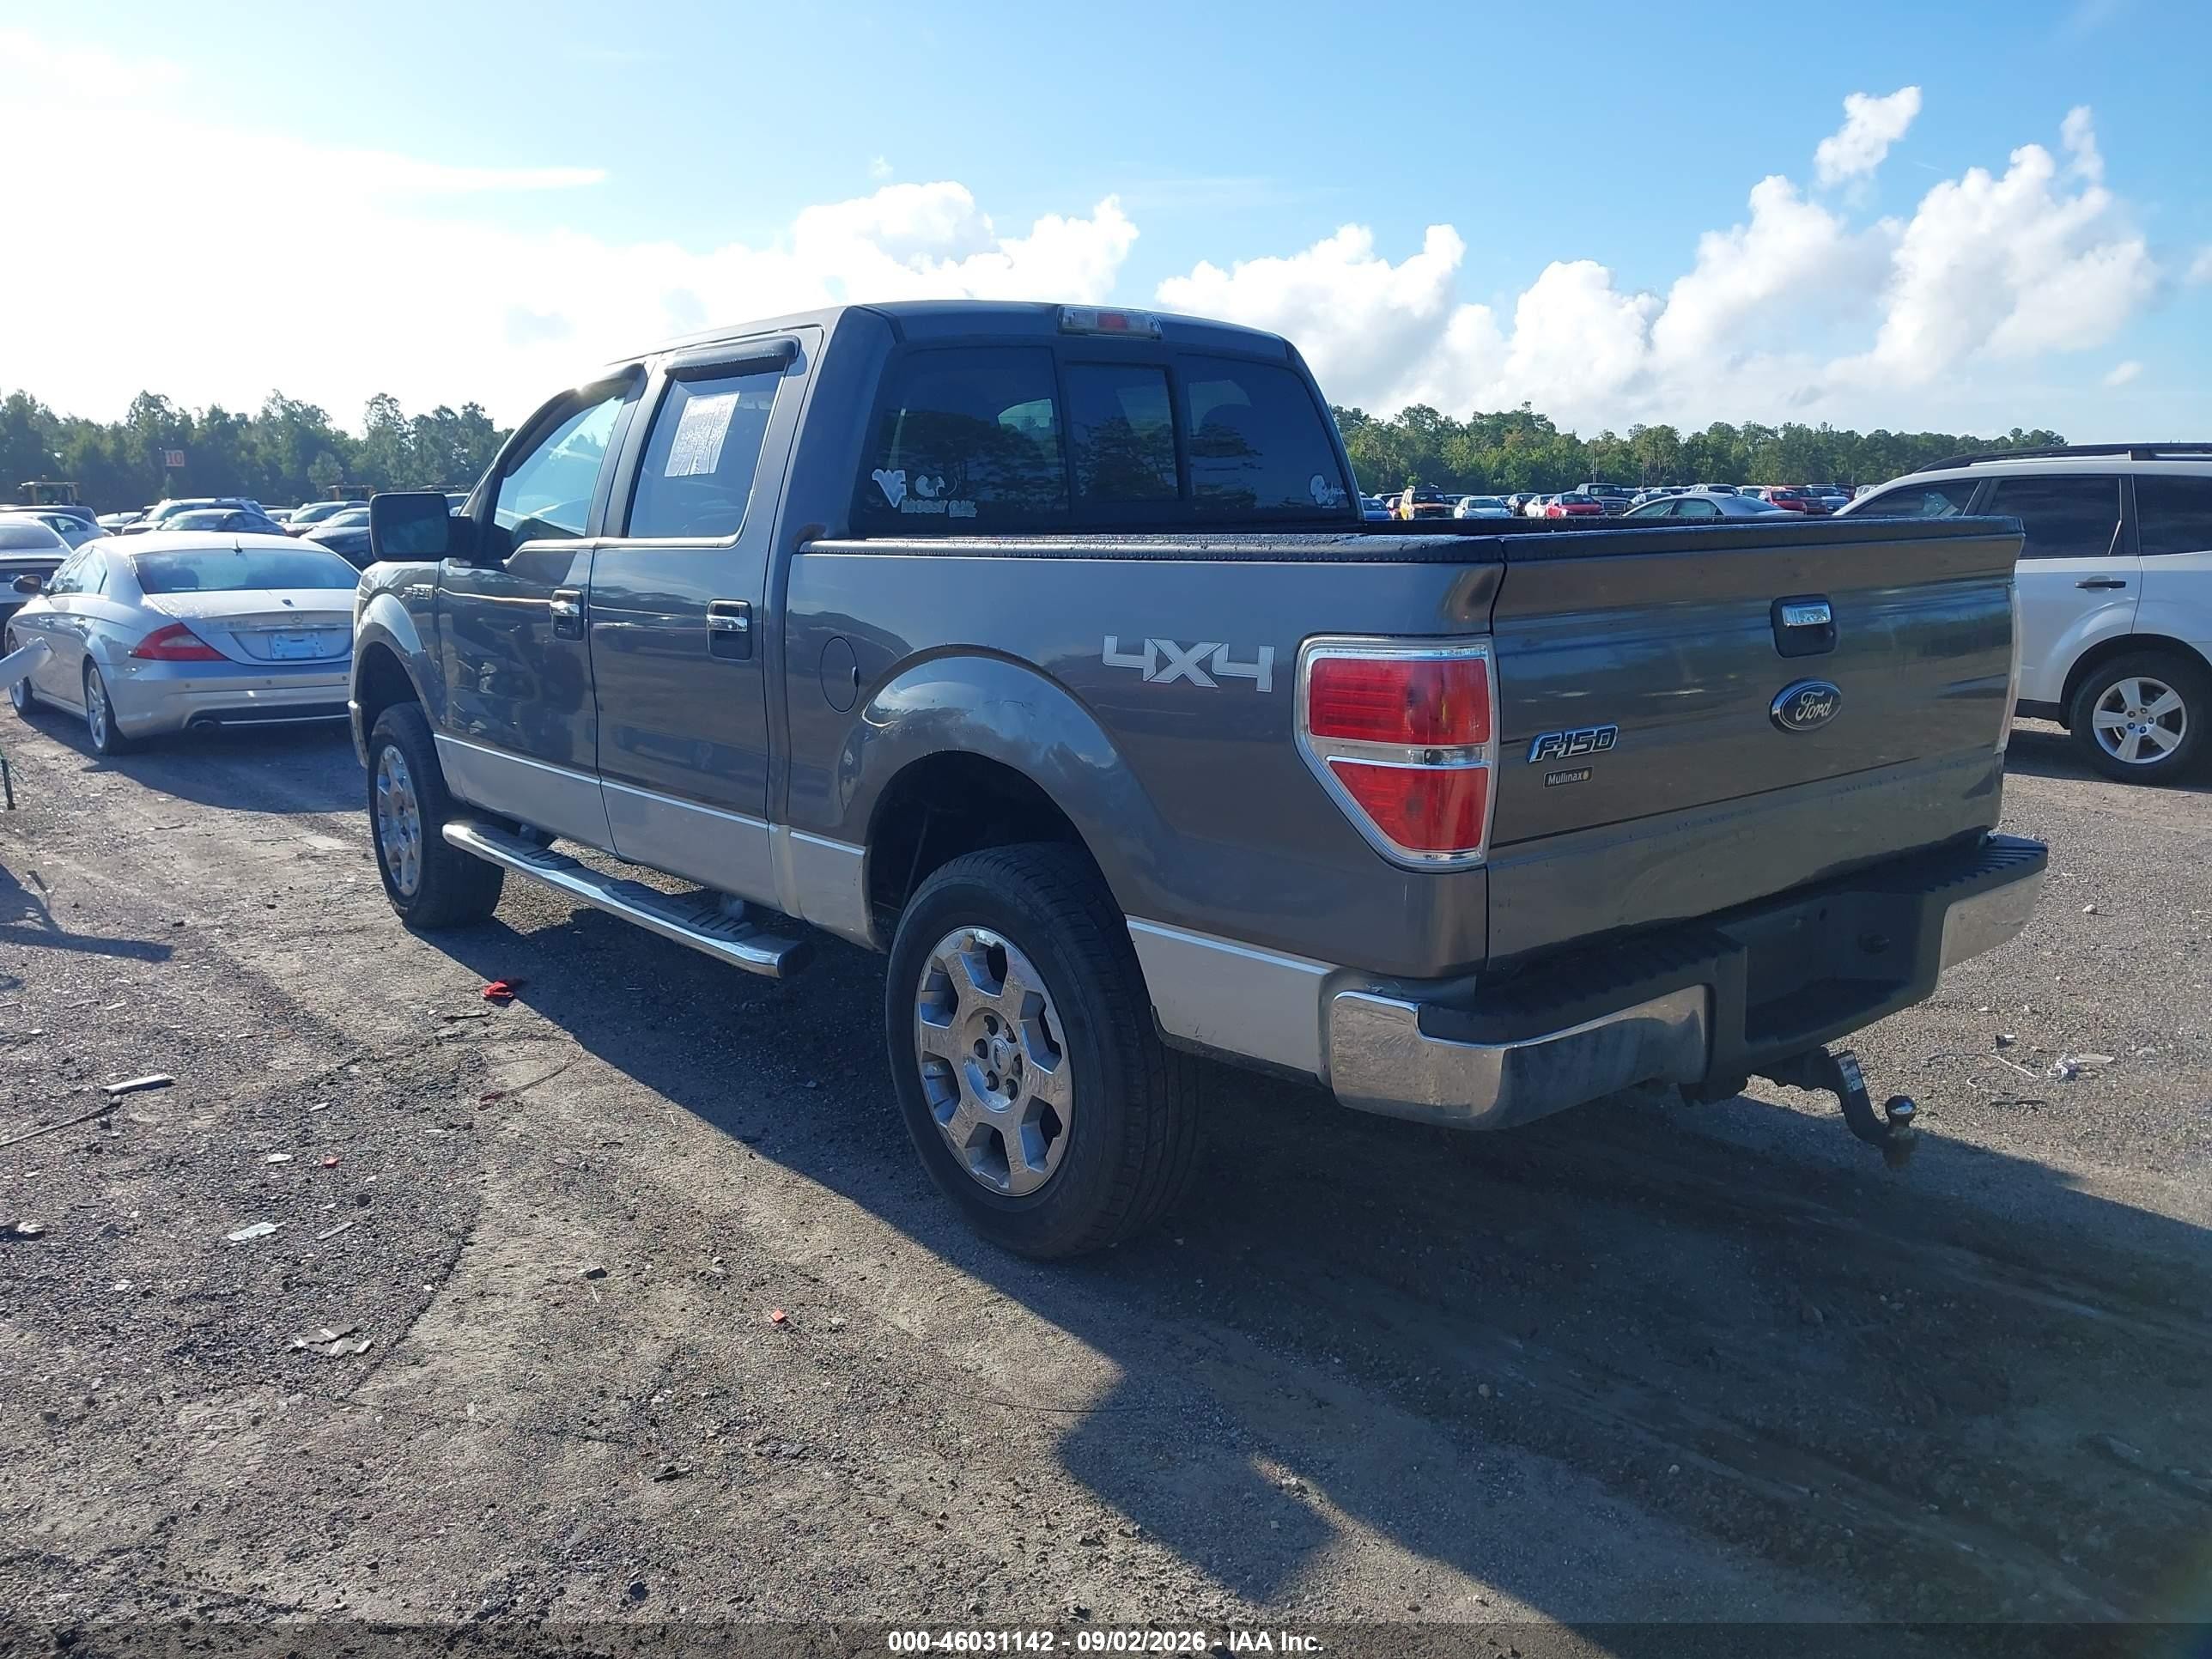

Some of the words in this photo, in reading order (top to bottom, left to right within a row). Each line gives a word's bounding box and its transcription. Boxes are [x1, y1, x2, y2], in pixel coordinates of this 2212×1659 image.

[167, 452, 182, 465] 10
[1796, 690, 1833, 721] Ford
[1529, 726, 1618, 763] F-150
[1547, 772, 1582, 786] Mullinax
